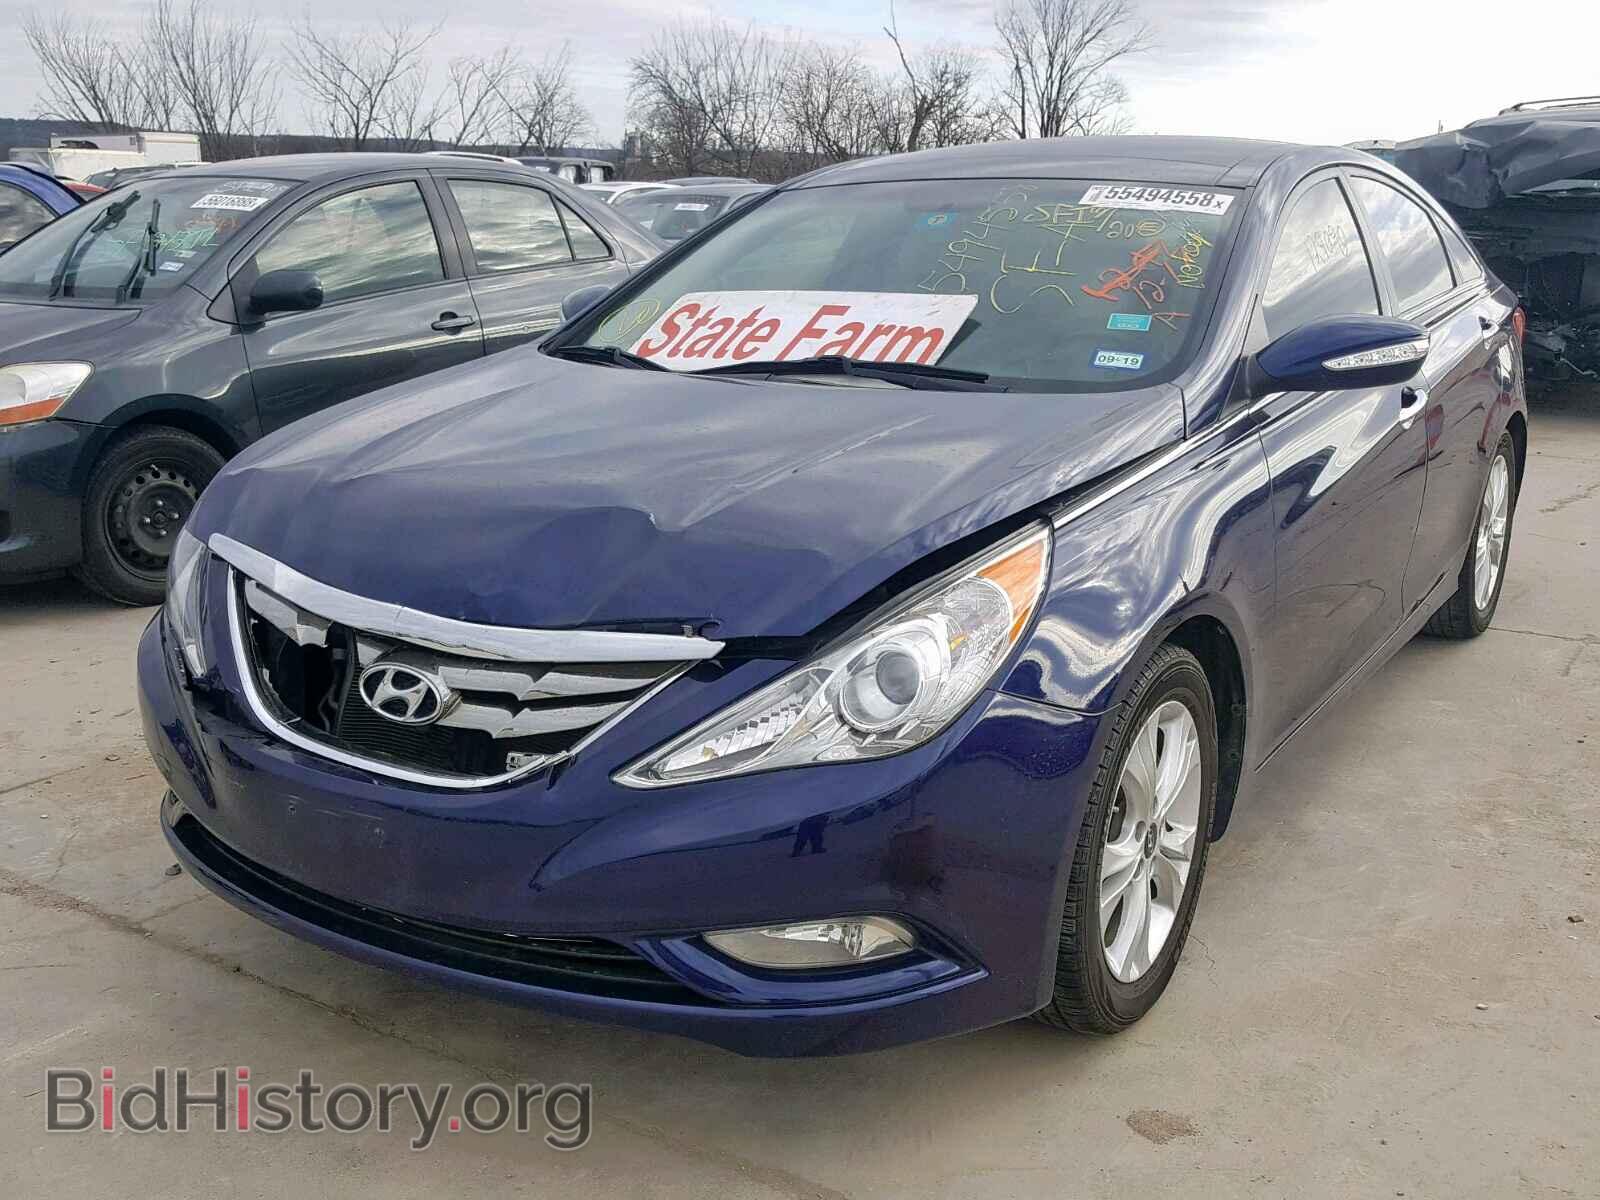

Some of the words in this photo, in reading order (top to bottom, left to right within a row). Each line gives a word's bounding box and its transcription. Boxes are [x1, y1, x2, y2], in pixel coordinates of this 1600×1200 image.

[1104, 185, 1215, 208] 55494558
[635, 302, 782, 361] State
[774, 304, 946, 366] Farm
